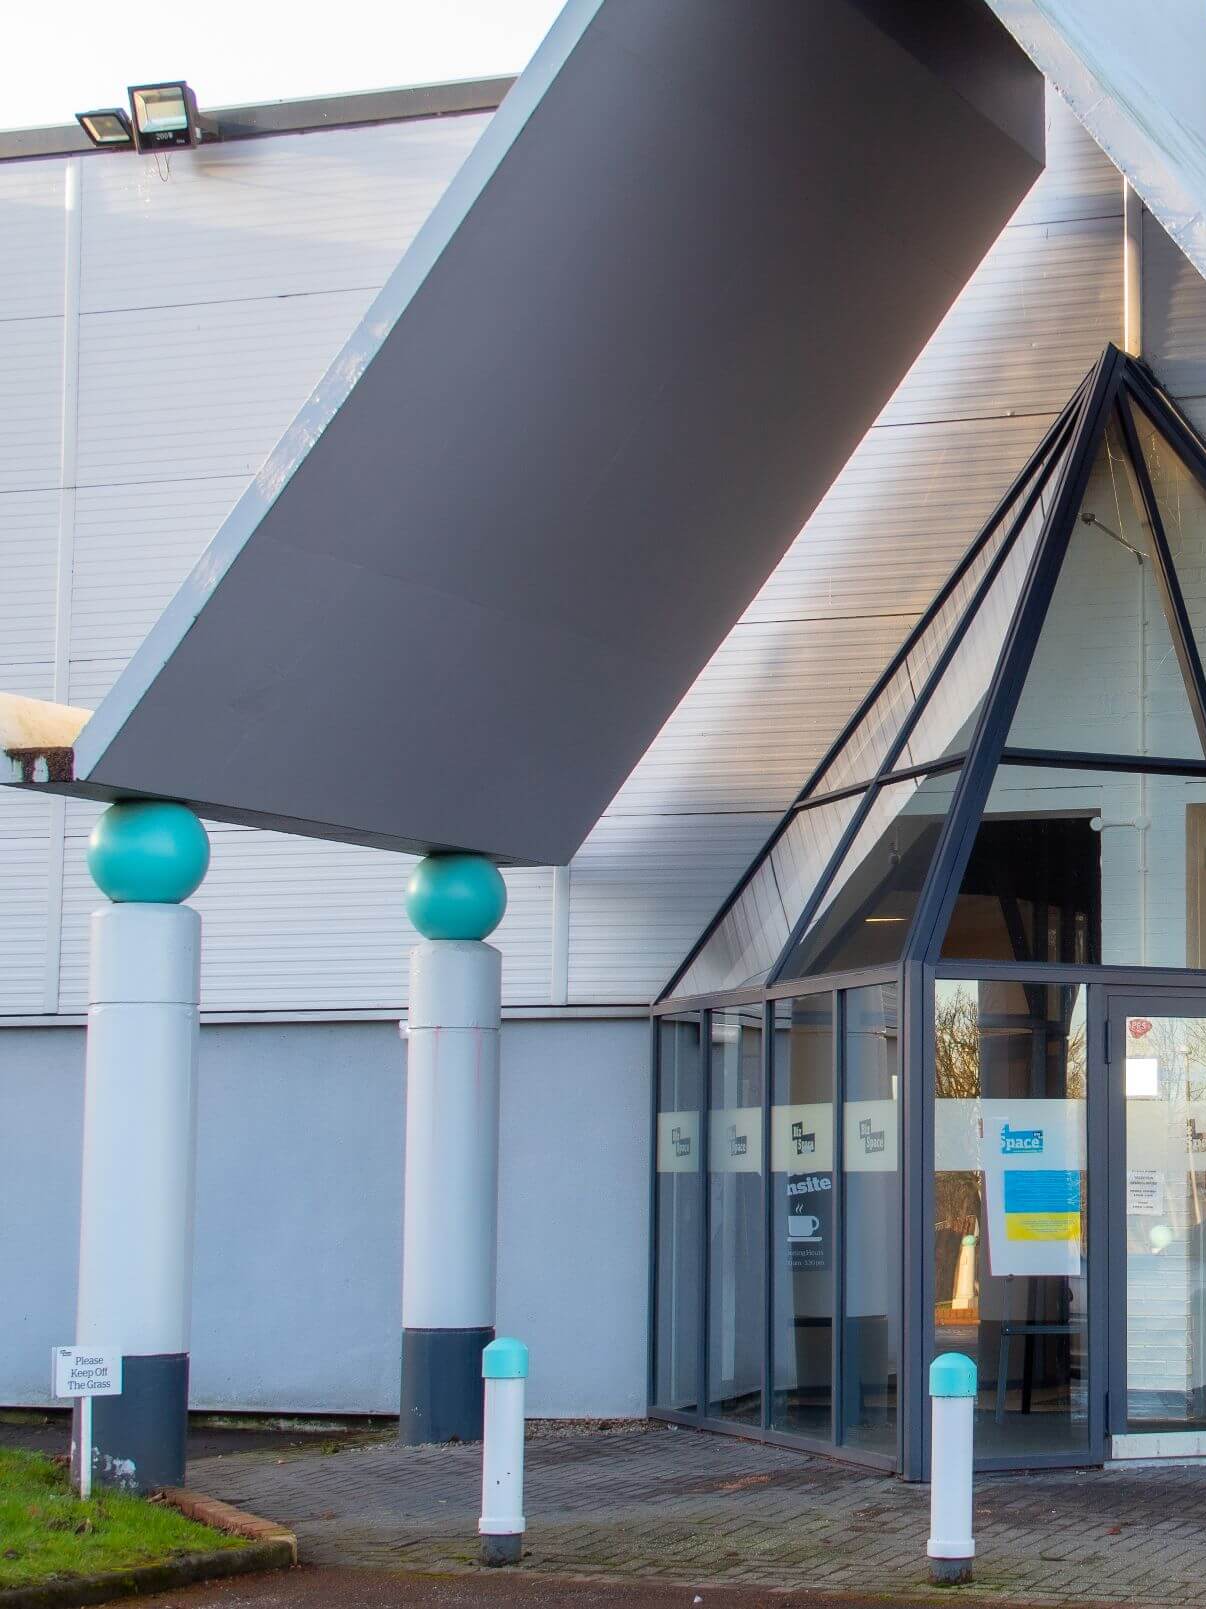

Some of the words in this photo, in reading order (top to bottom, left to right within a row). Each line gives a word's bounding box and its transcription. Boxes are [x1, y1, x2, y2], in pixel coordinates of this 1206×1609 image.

[786, 1176, 832, 1196] nsite
[75, 1356, 104, 1365] Please
[71, 1368, 94, 1378] Keep
[95, 1367, 107, 1376] Off
[68, 1380, 86, 1390] The
[87, 1380, 111, 1389] Grass
